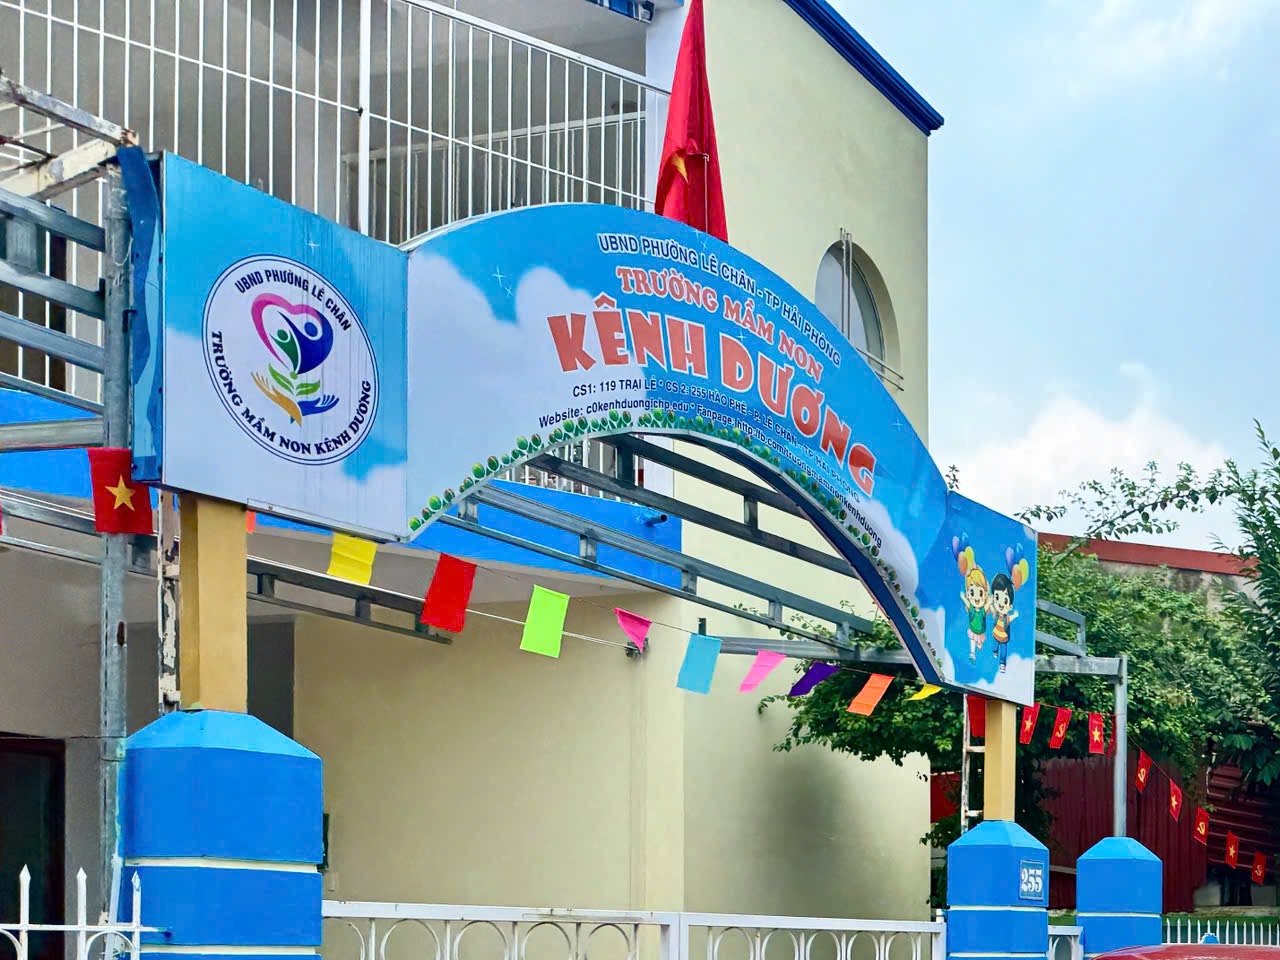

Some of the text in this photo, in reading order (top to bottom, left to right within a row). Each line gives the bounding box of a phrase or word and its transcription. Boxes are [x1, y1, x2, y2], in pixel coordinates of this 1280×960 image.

[235, 270, 351, 331] UBND PHƯỜNG LÊ CHÂN
[598, 235, 638, 252] UBND
[642, 238, 698, 266] PHƯỜNG
[701, 255, 718, 275] LÊ
[721, 263, 755, 295] CHÂN
[765, 292, 780, 310] TP
[782, 303, 802, 327] HẢI
[804, 322, 841, 367] PHÒNG
[617, 267, 823, 381] TRƯỜNG MẦM NON
[212, 331, 371, 455] TRƯỜNG MẦM NON KÊNH DƯƠNG
[539, 408, 584, 428] Website:
[548, 294, 876, 497] KÊNH DƯƠNG
[573, 384, 596, 397] CS1:
[600, 381, 616, 392] 119
[665, 381, 679, 393] CS
[692, 386, 707, 399] 255
[1021, 868, 1043, 892] 255
